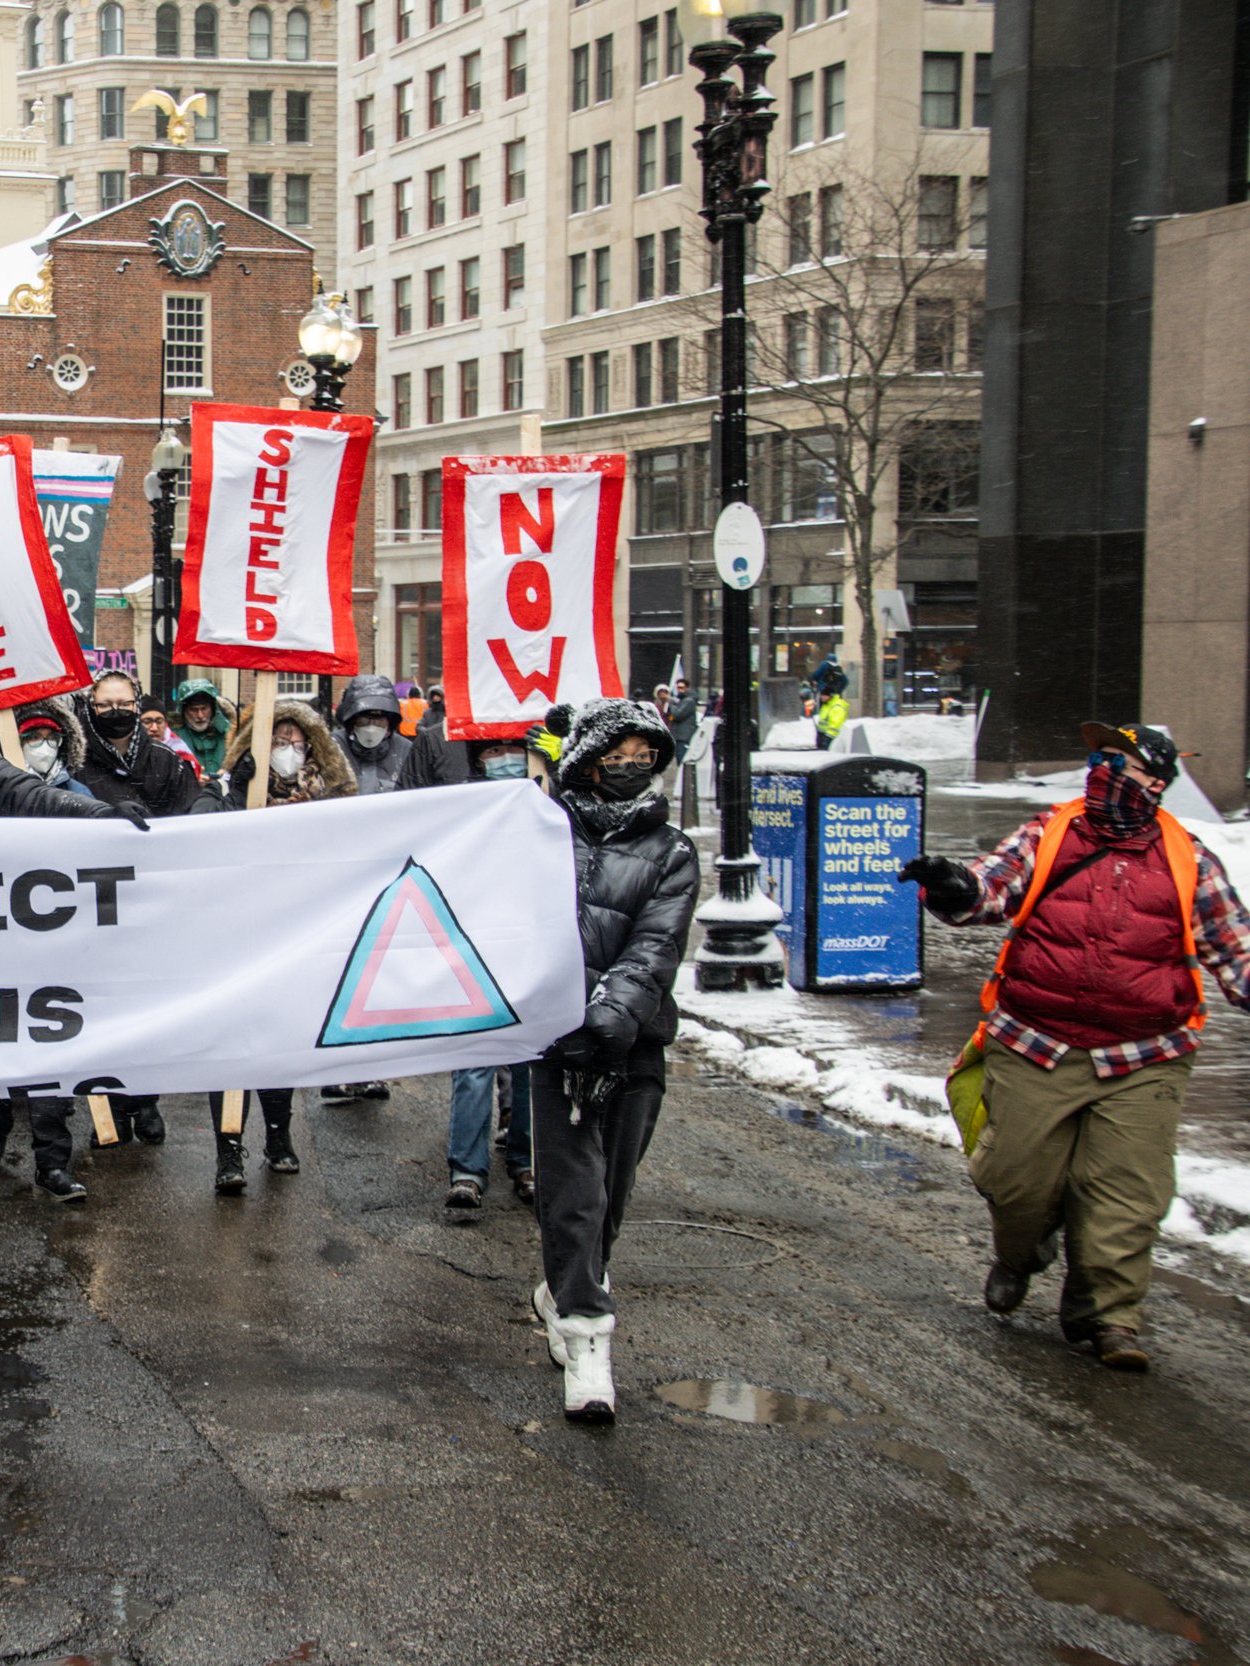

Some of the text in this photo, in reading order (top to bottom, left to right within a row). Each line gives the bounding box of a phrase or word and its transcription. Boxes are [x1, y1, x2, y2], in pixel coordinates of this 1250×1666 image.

[38, 503, 94, 543] NS
[245, 428, 294, 642] SHIELD
[486, 487, 567, 704] NOW
[824, 803, 906, 820] Scan the
[824, 821, 911, 838] street for
[824, 839, 891, 855] wheels
[823, 856, 904, 873] and feet.
[823, 882, 895, 894] Look all ways,
[823, 895, 846, 905] look
[822, 935, 890, 949] massDOT
